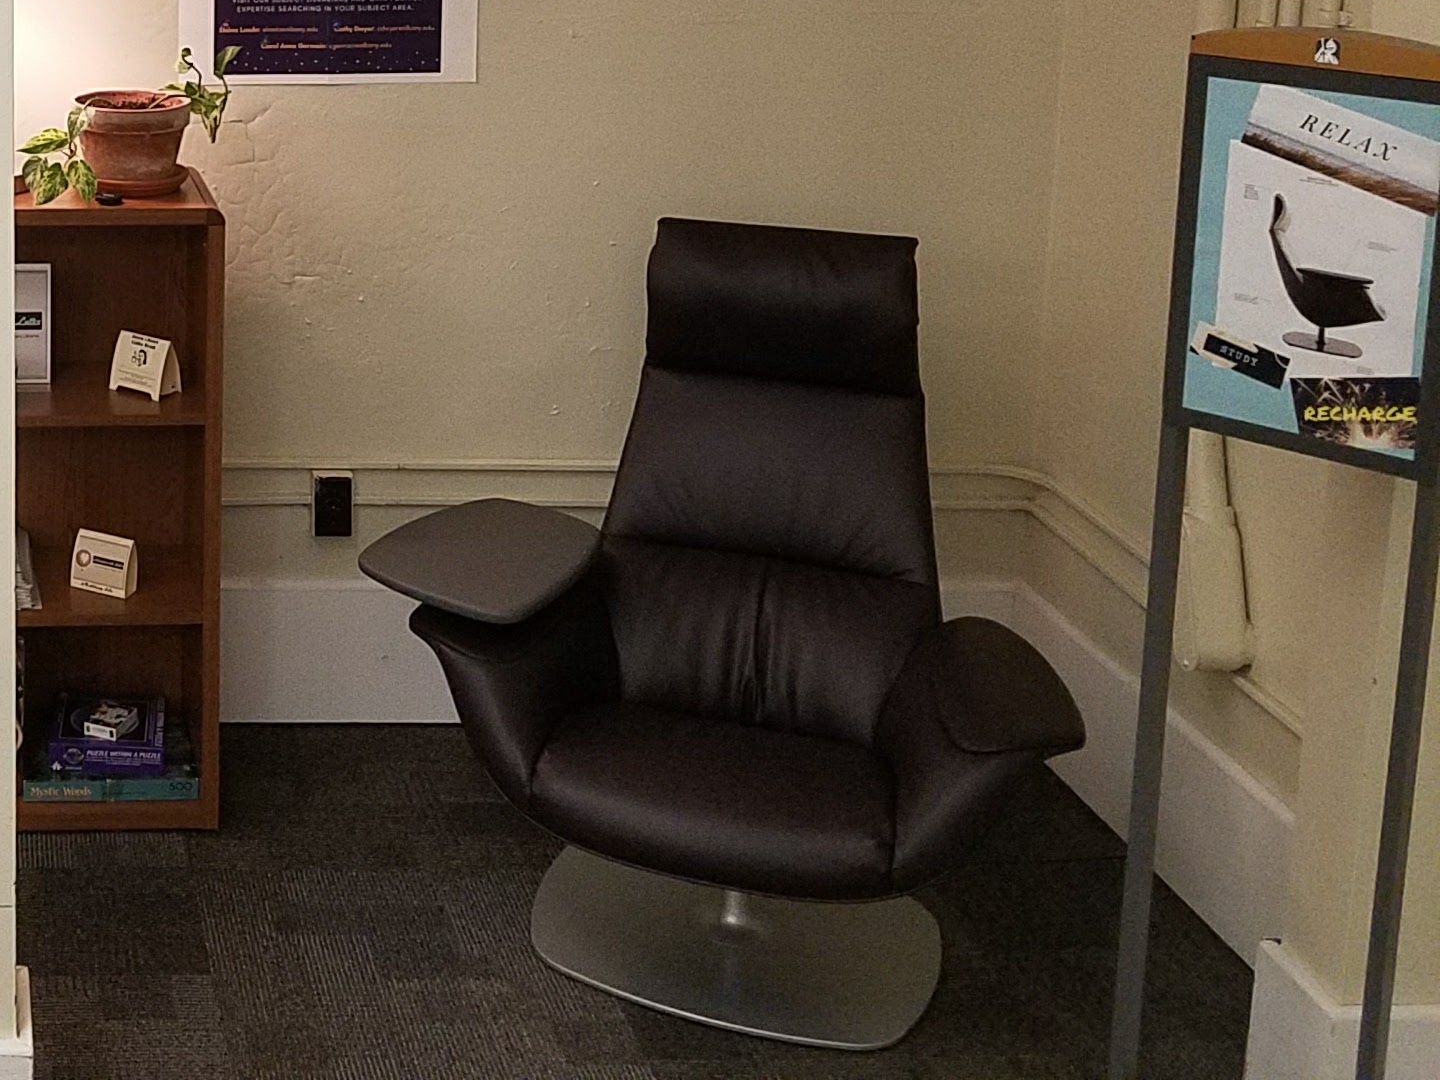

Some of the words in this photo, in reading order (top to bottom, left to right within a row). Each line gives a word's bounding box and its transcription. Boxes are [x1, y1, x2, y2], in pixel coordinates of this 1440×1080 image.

[236, 5, 275, 13] EXPERTISE
[334, 4, 355, 12] YOUR
[1299, 114, 1397, 161] RELAX
[1219, 345, 1259, 367] STUDY
[1303, 406, 1417, 424] RECHARGE
[86, 749, 108, 758] PUZZLE
[30, 786, 59, 798] Mystic
[168, 782, 193, 791] 500
